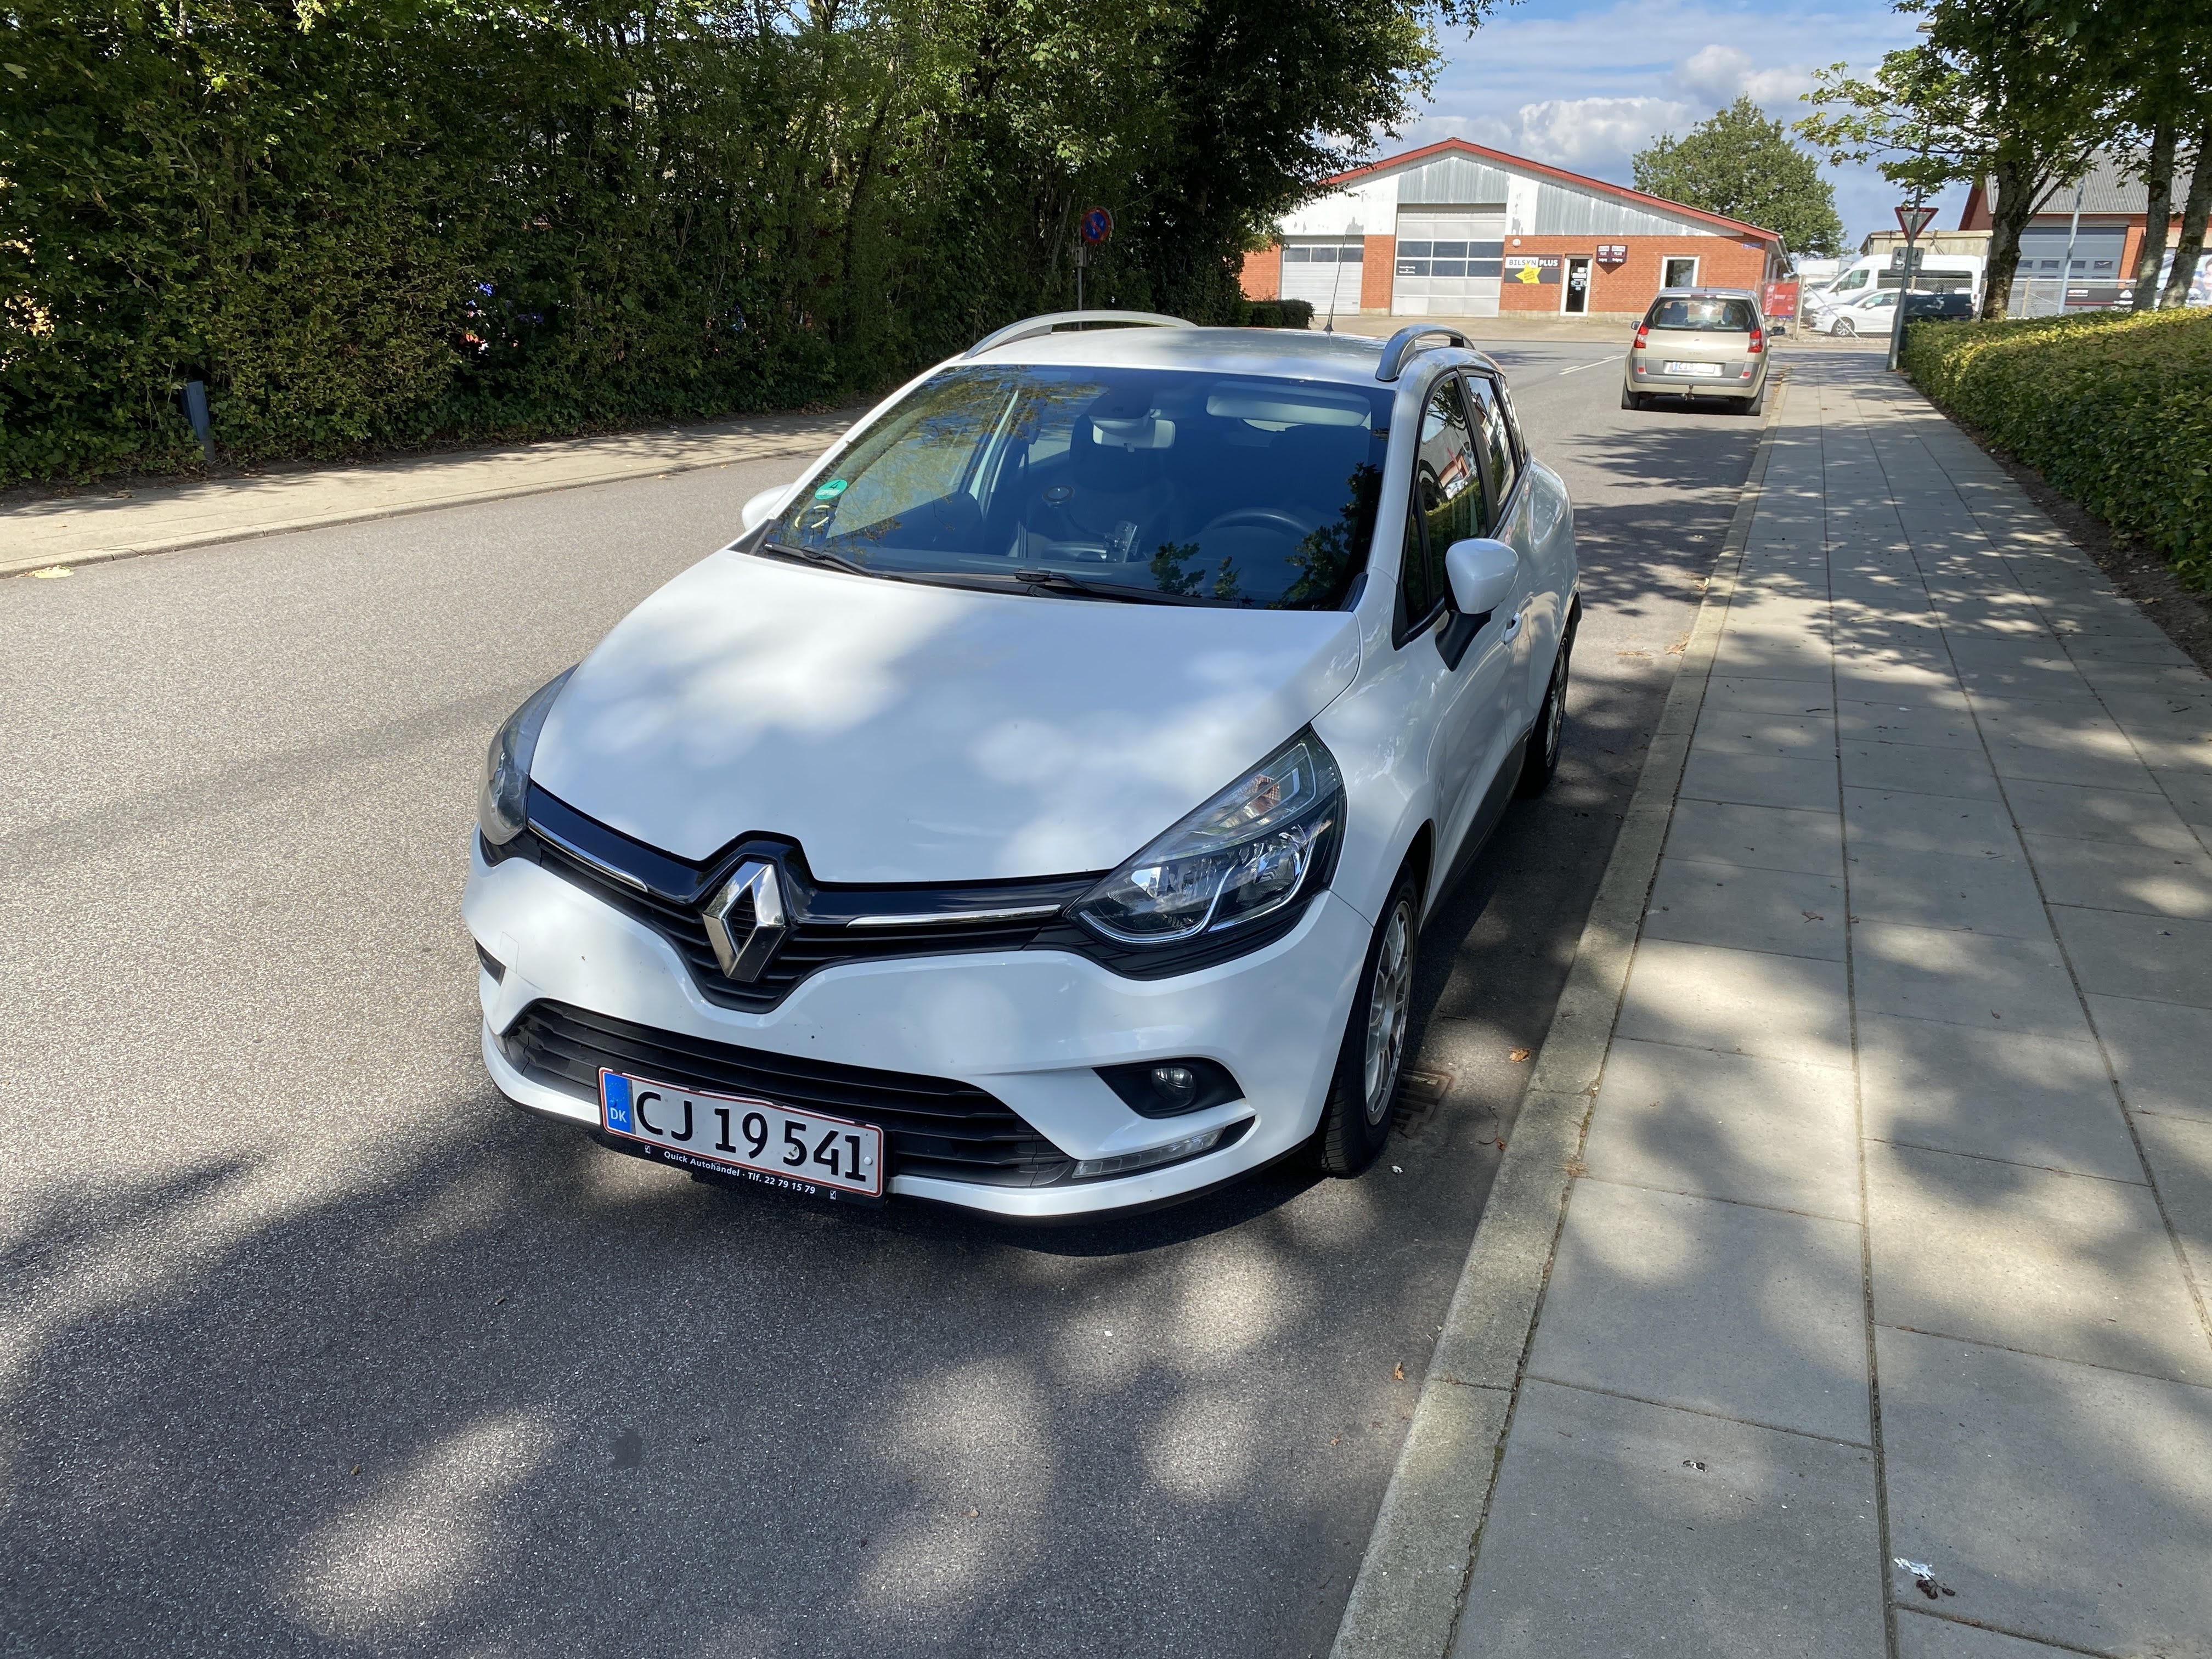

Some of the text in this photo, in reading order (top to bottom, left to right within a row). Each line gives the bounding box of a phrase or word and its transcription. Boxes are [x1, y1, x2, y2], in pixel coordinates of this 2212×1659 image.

[829, 480, 841, 489] 4
[610, 1107, 627, 1124] DK
[636, 1091, 867, 1182] CJ 19 541
[664, 1151, 687, 1163] Quick
[748, 1172, 762, 1182] Tlf.
[764, 1176, 775, 1186] 22
[778, 1180, 789, 1188] 79
[792, 1182, 802, 1191] 15
[804, 1185, 816, 1194] 79
